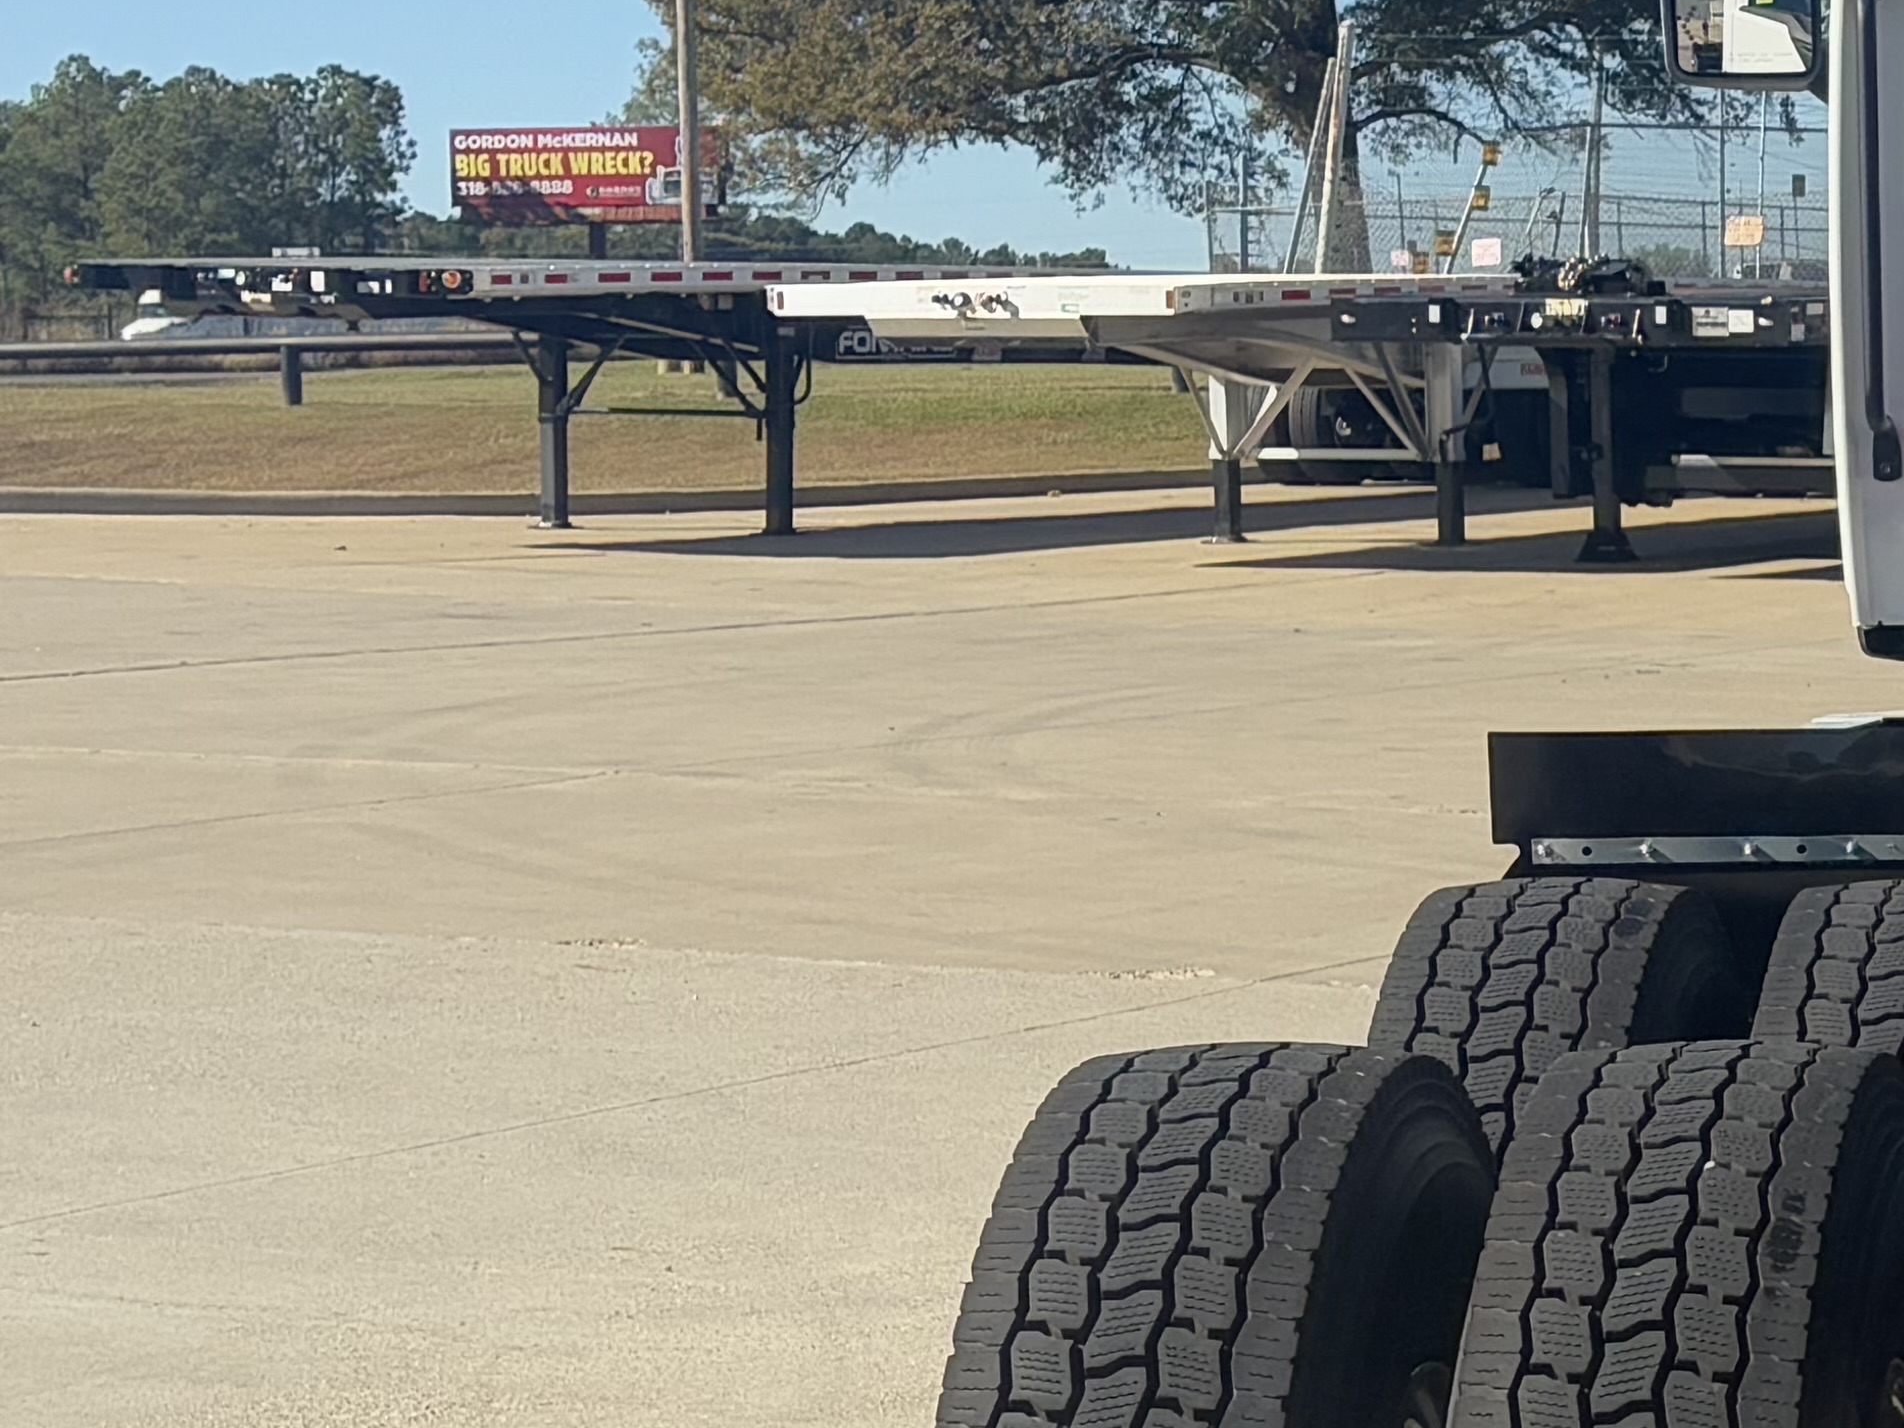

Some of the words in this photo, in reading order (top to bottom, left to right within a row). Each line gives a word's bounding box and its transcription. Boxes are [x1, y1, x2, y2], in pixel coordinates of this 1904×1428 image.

[454, 134, 534, 150] GORDON
[537, 132, 638, 148] McKERNAN
[454, 153, 491, 177] BIG
[496, 152, 564, 176] TRUCK
[569, 151, 654, 174] WRECK?
